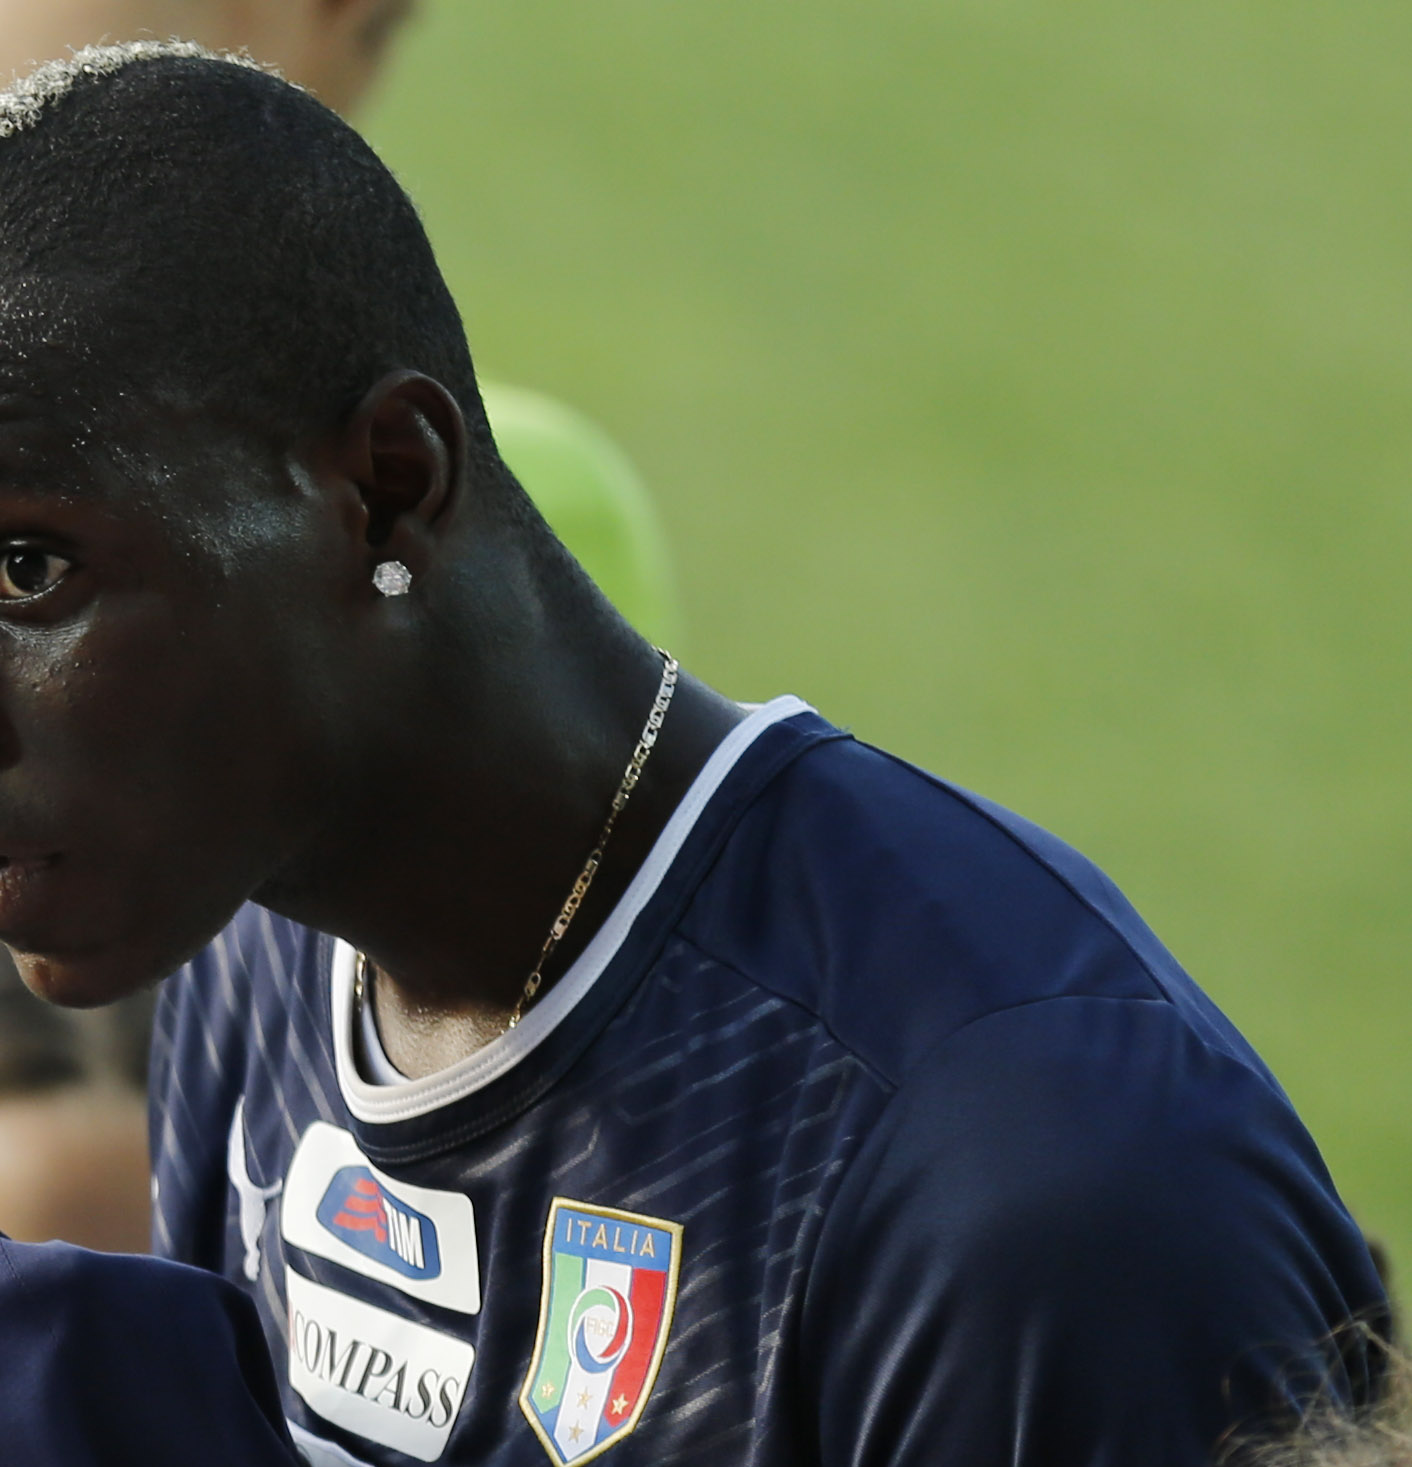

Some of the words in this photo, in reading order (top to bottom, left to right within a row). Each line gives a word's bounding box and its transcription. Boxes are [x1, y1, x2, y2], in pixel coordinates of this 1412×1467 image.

[382, 1196, 425, 1270] TIM
[566, 1217, 655, 1258] ITALIA
[294, 1309, 461, 1428] COMPASS
